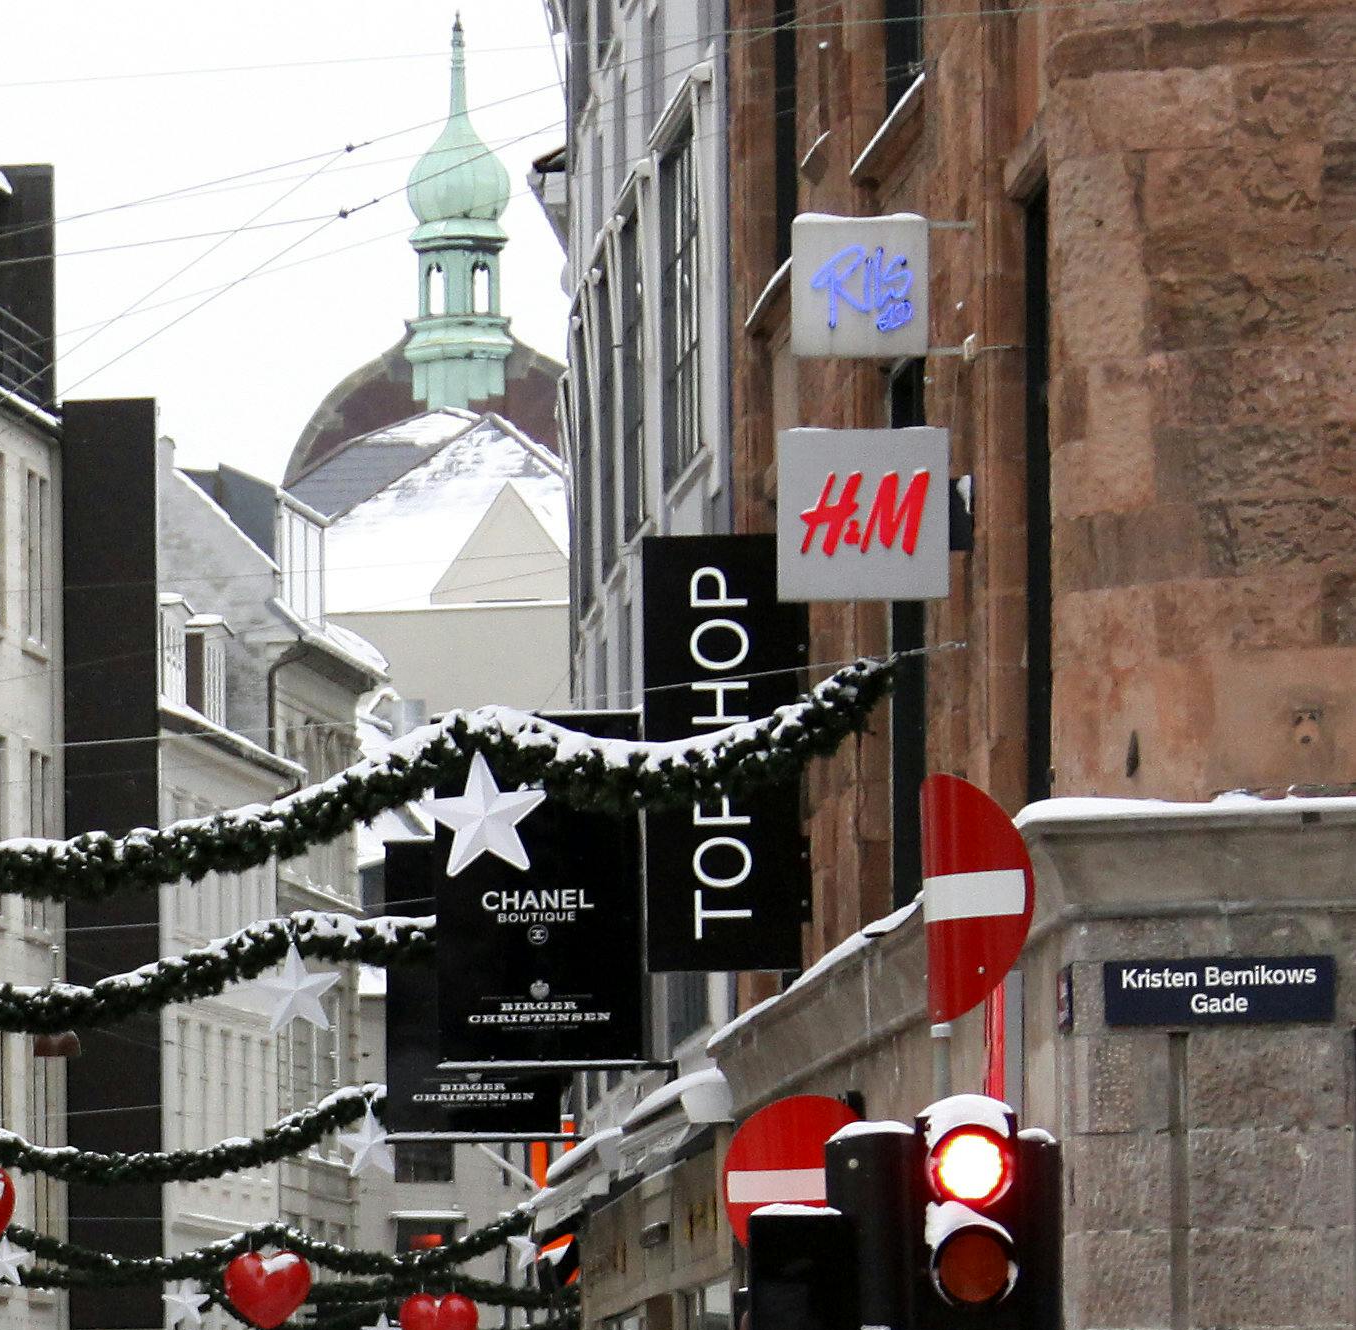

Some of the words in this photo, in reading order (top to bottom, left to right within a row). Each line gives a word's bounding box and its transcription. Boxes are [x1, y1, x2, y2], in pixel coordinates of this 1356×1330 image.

[800, 468, 930, 556] H&M
[690, 566, 753, 940] TOPHOP
[481, 888, 595, 911] CHANEL
[497, 911, 577, 924] BOUTIQUE
[1121, 968, 1197, 989] Kristen
[1205, 965, 1317, 987] Bernikows
[500, 1001, 579, 1012] BIRGER
[1190, 993, 1249, 1014] Gade
[467, 1012, 612, 1024] CHRISTENSEN
